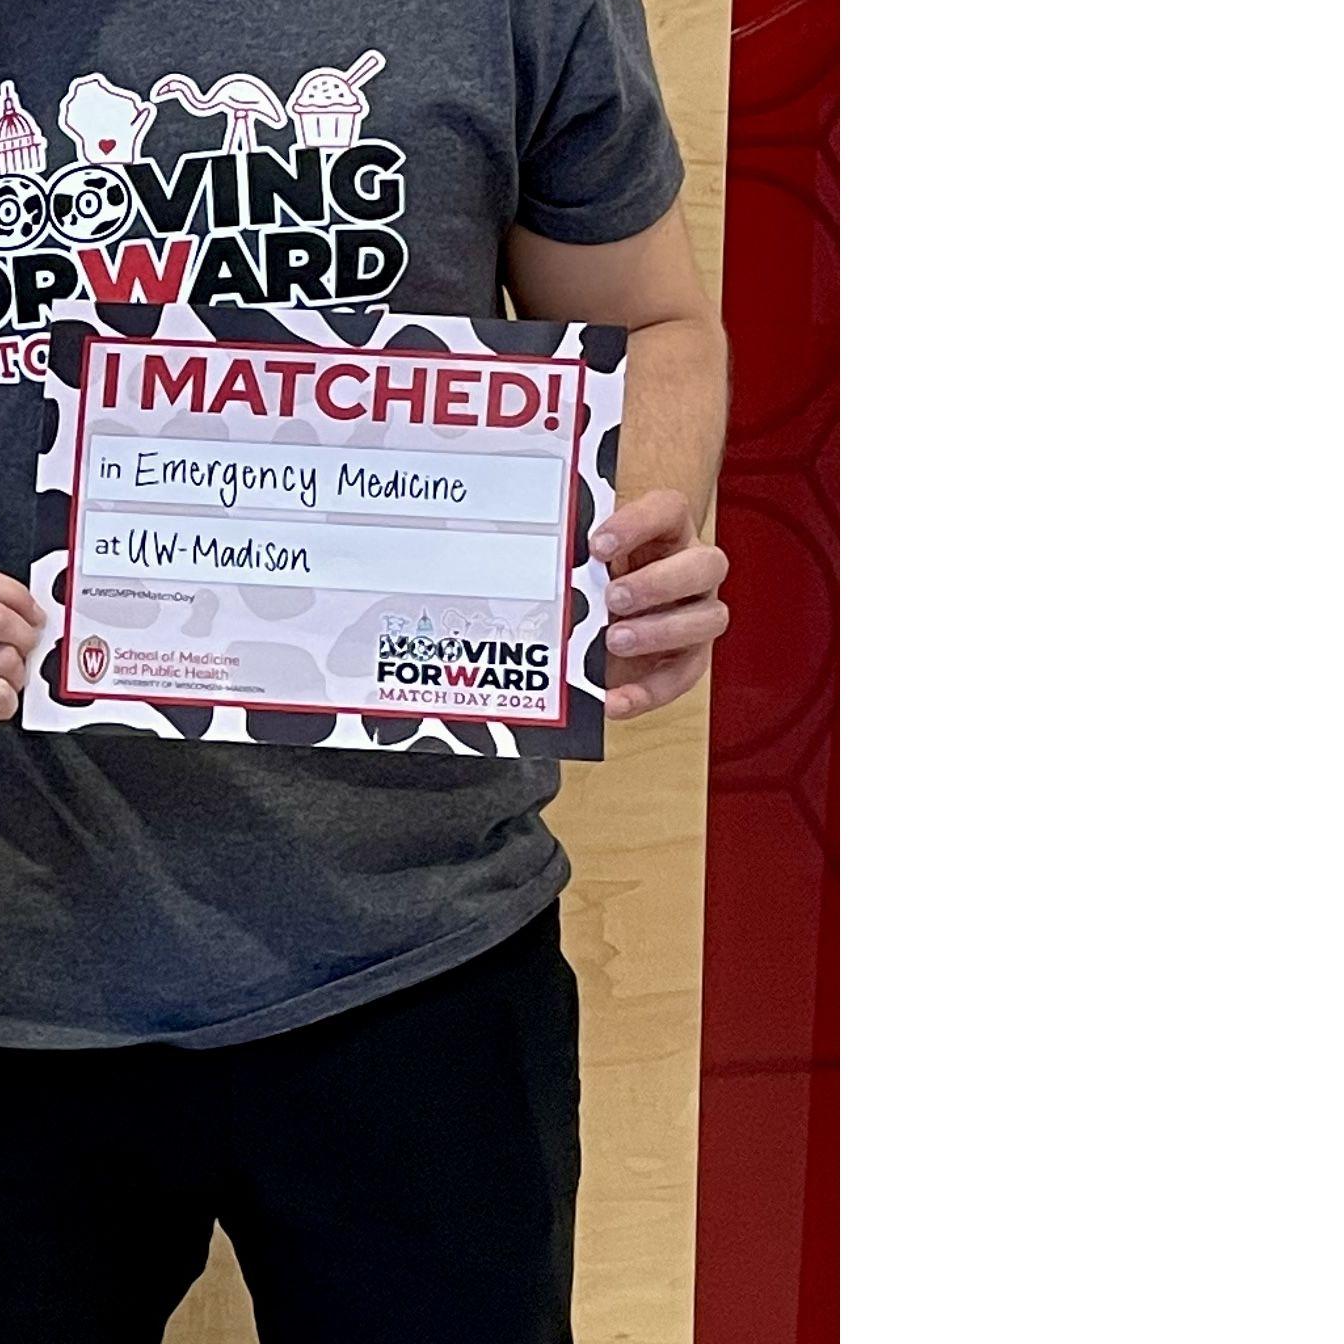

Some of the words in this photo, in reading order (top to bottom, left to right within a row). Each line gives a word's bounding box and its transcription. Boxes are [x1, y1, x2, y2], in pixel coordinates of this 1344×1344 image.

[102, 352, 120, 409] I
[140, 354, 562, 432] MATCHED!
[99, 457, 121, 479] in
[135, 452, 317, 507] Emergency
[337, 463, 467, 503] Medicine
[95, 538, 120, 556] at
[128, 528, 311, 573] UW-Madison
[114, 647, 158, 662] School
[162, 649, 175, 663] of
[179, 651, 240, 667] Medicine
[379, 634, 550, 668] MOOVING
[113, 662, 138, 676] and
[141, 662, 181, 678] Public
[185, 665, 229, 681] Health
[377, 661, 550, 692] FORWARD
[379, 687, 448, 705] MATCH
[453, 692, 492, 707] DAY
[496, 693, 547, 712] 2024
